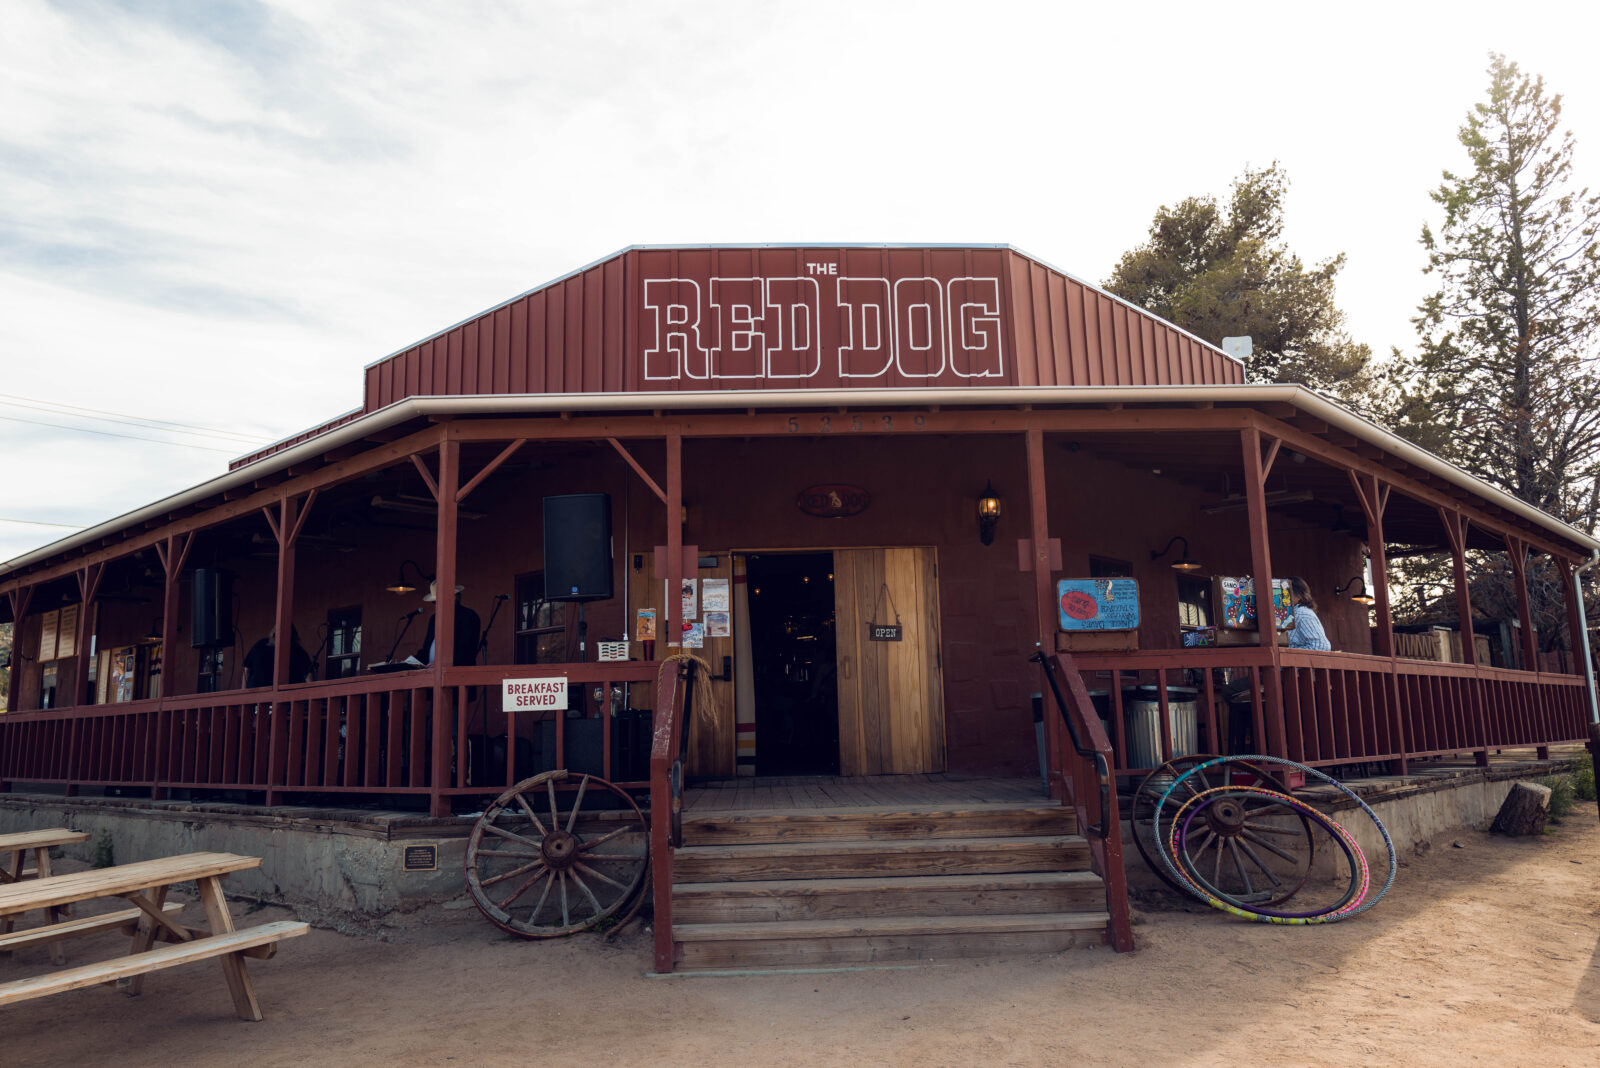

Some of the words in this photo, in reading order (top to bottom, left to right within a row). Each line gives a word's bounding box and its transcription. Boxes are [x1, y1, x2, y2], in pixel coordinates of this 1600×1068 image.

[807, 263, 838, 275] THE
[645, 277, 820, 380] RED
[837, 277, 1003, 378] DOG
[875, 628, 897, 638] OPEN
[507, 682, 565, 695] BREAKFAST
[516, 694, 556, 706] SERVED
